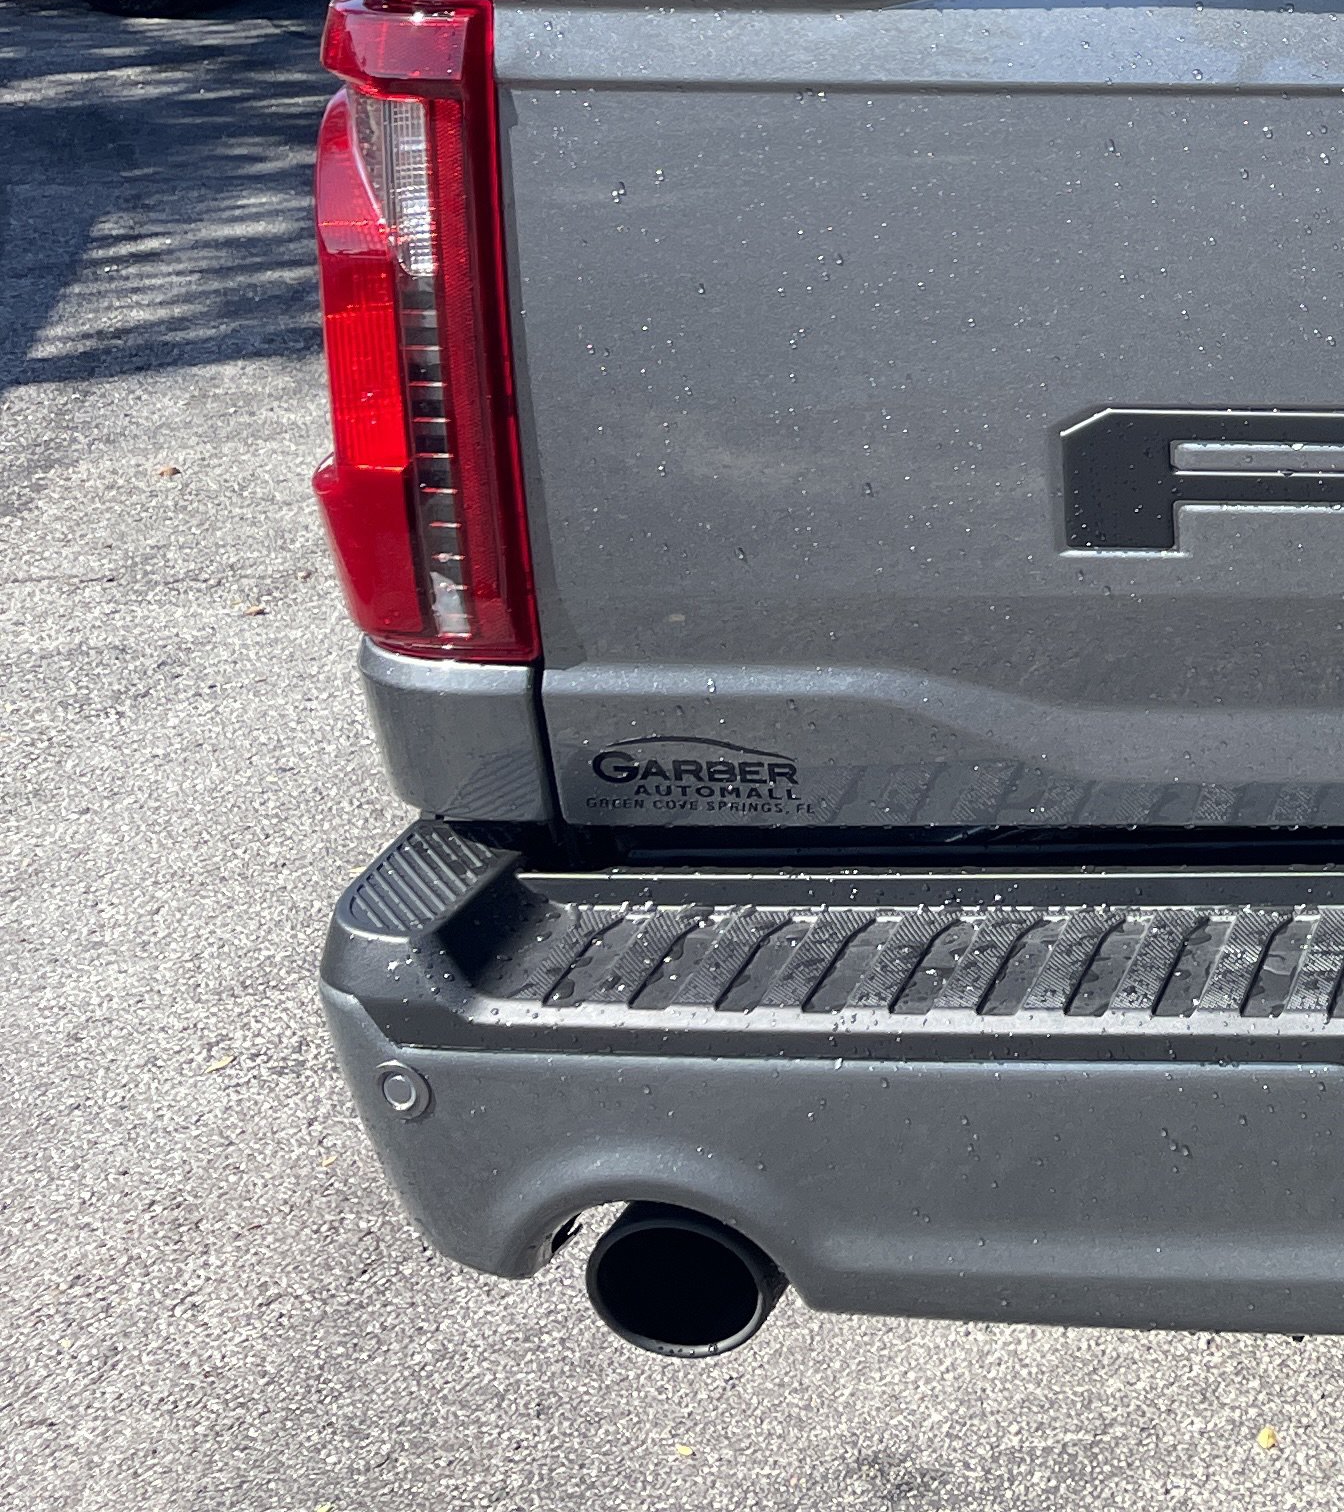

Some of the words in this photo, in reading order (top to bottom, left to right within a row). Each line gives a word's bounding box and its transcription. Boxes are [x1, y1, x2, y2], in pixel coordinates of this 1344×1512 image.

[591, 750, 800, 785] GARBER
[633, 783, 803, 801] AUTOMALL
[586, 797, 645, 811] GREEN
[652, 798, 699, 812] COVE
[795, 801, 816, 815] FL
